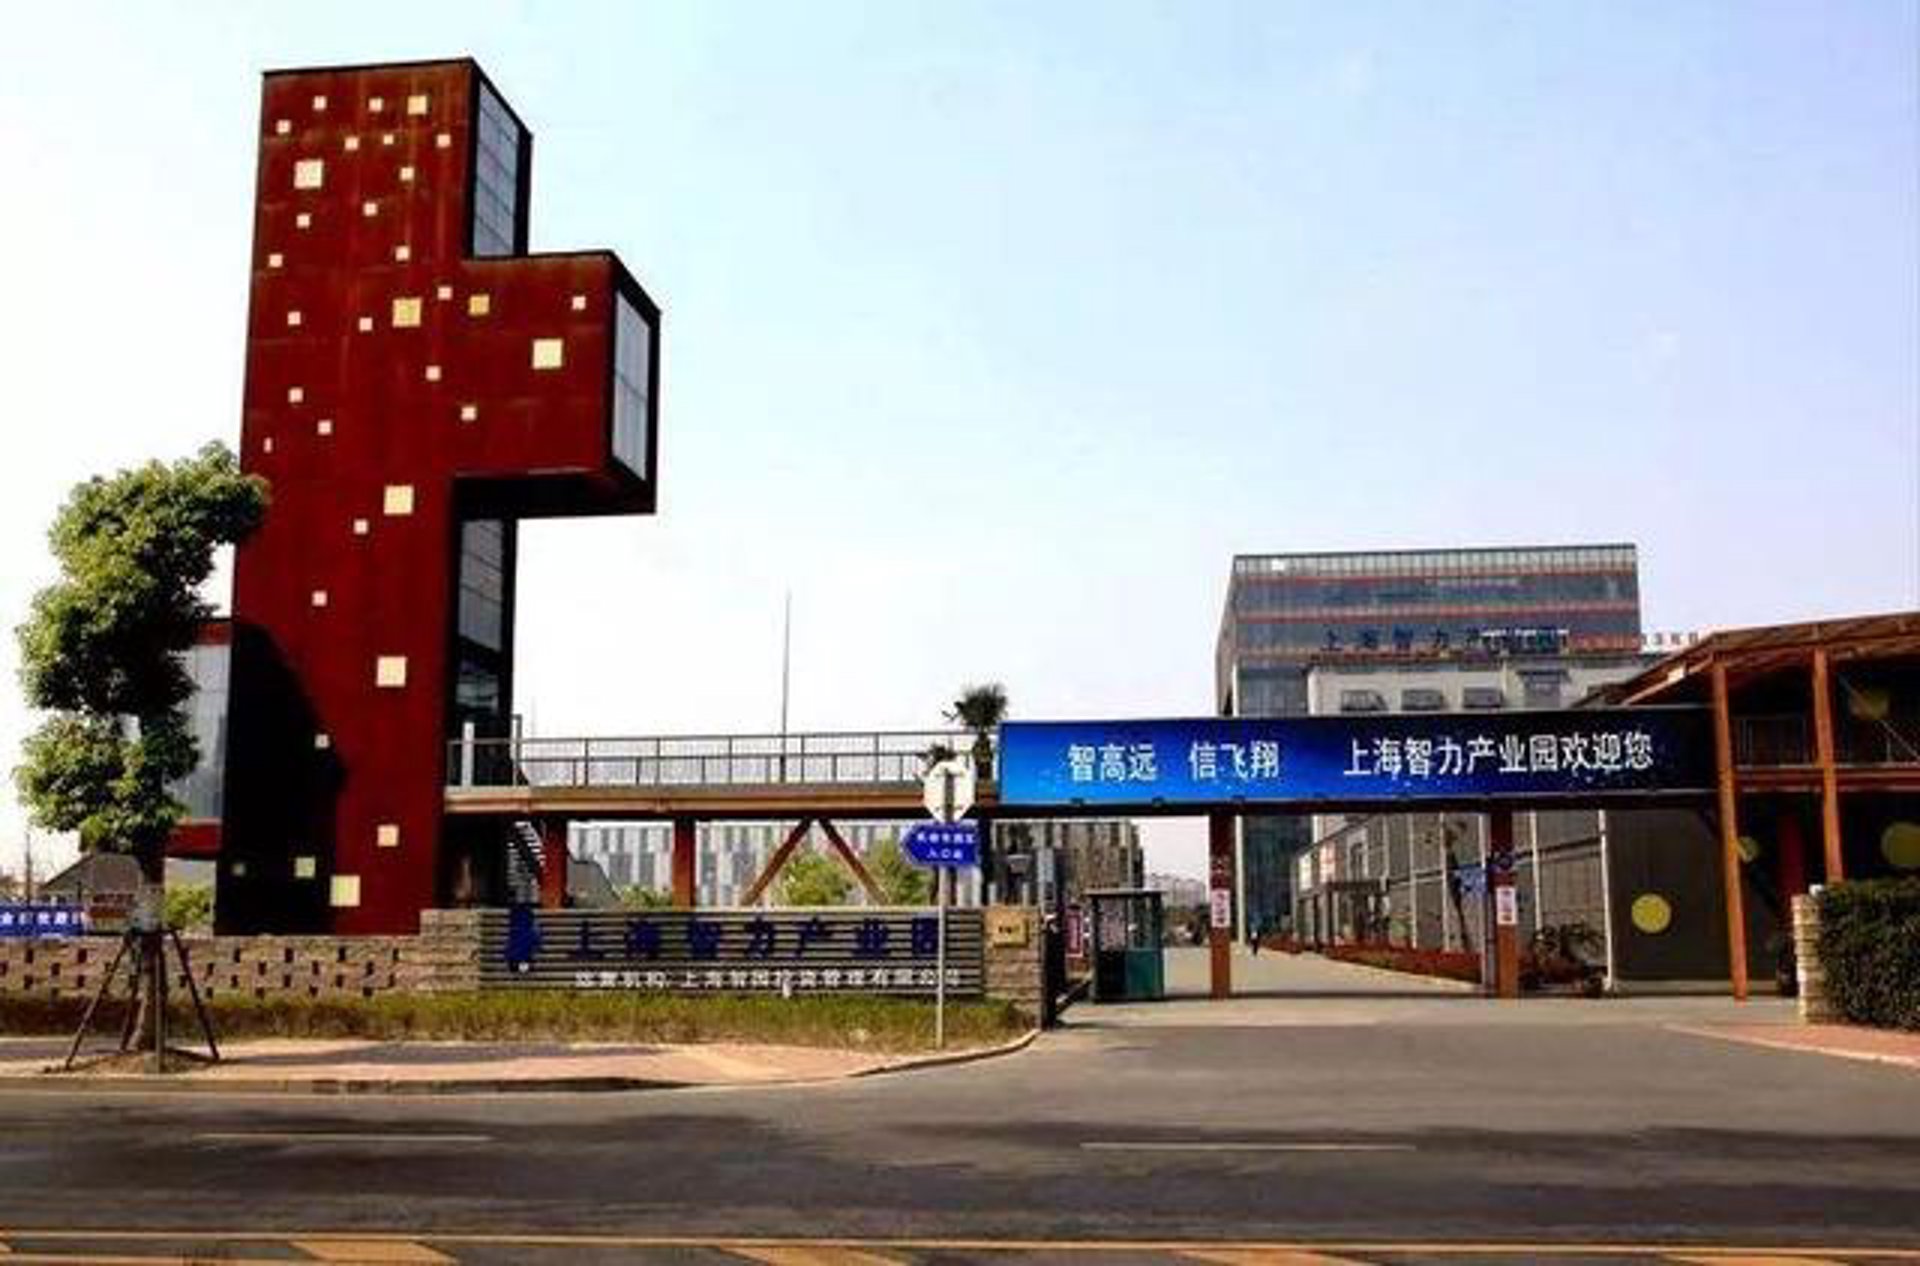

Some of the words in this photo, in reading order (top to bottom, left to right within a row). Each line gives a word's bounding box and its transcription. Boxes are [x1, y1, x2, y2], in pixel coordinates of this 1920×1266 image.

[1067, 743, 1158, 782] 智高远
[1188, 741, 1280, 780] 信飞翔
[1343, 730, 1654, 776] 上海智力产业园欢迎您
